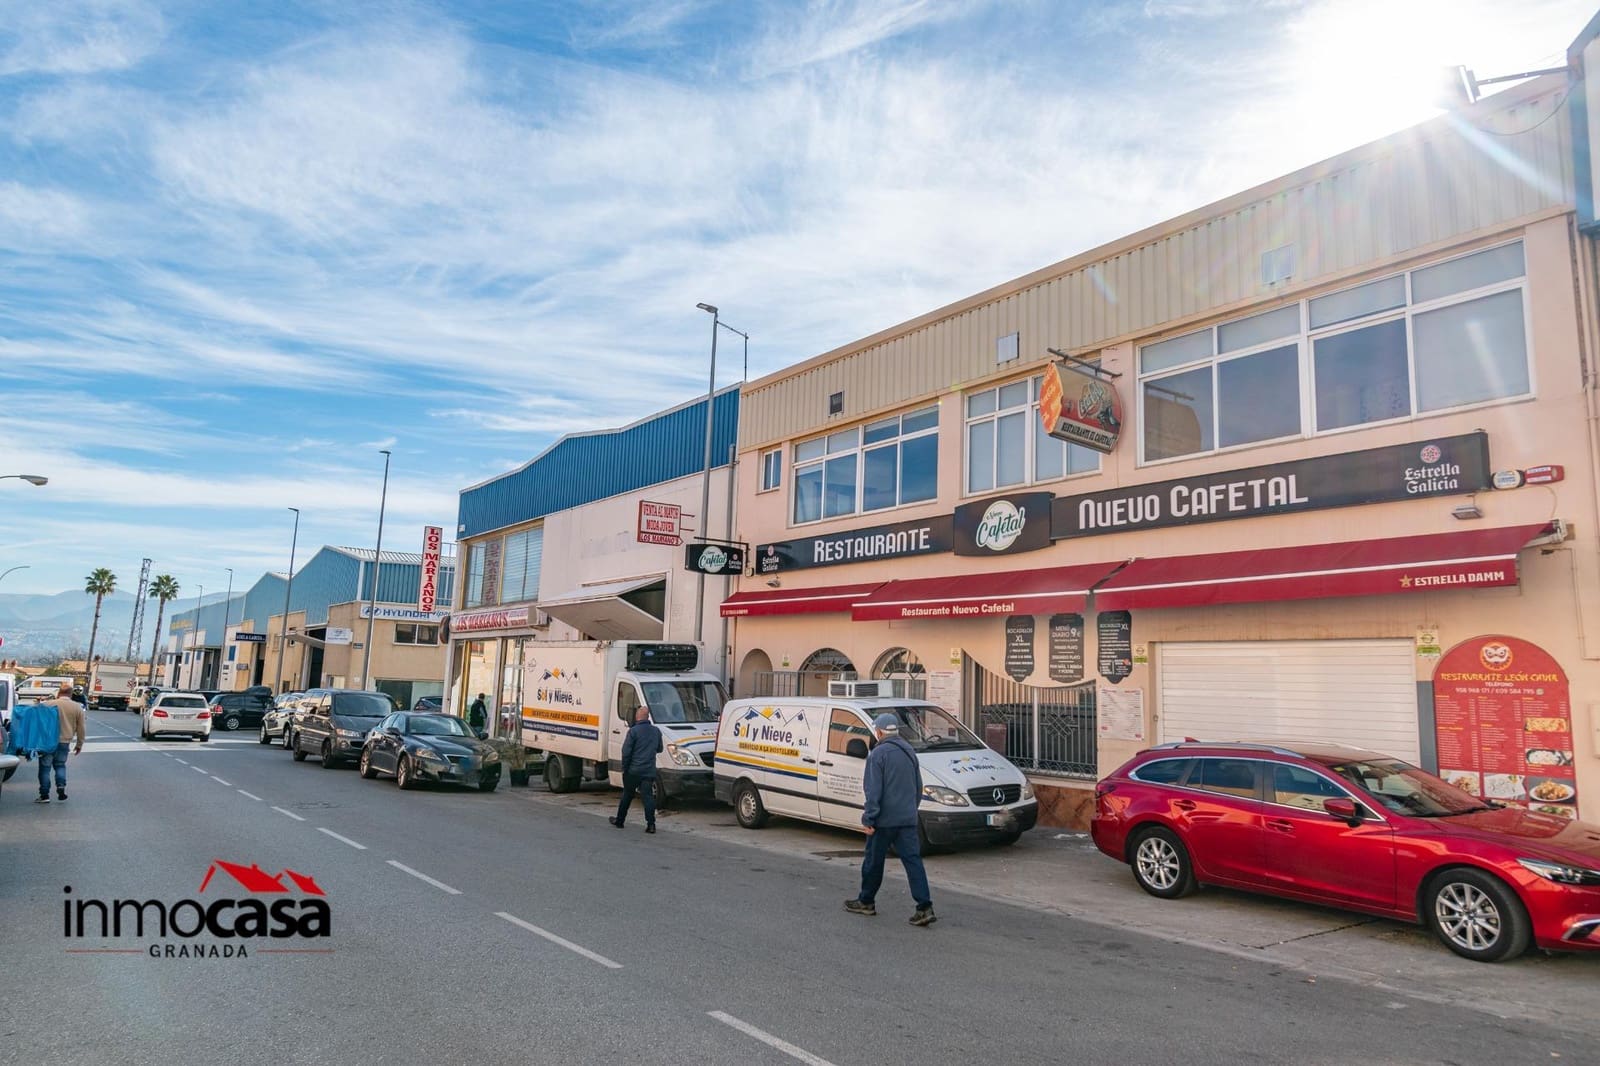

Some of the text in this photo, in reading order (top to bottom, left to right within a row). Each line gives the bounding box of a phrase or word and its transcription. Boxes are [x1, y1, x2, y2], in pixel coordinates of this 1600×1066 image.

[1404, 463, 1460, 480] Estrella
[1406, 477, 1458, 494] Galicia
[1079, 474, 1309, 530] NUEVO CAFETAL
[977, 509, 1024, 545] Cafetal
[427, 528, 439, 550] LOS
[641, 534, 650, 542] LOS
[814, 528, 930, 563] RESTAURANTE
[1415, 571, 1504, 586] ESTRELLA DAMM
[901, 602, 1014, 616] Restaurante Nuevo Cafetal
[1441, 672, 1502, 681] RESTAURANTE
[537, 689, 547, 701] Sol
[548, 692, 553, 704] y
[733, 722, 808, 746] Sol y Nieve, s.l.
